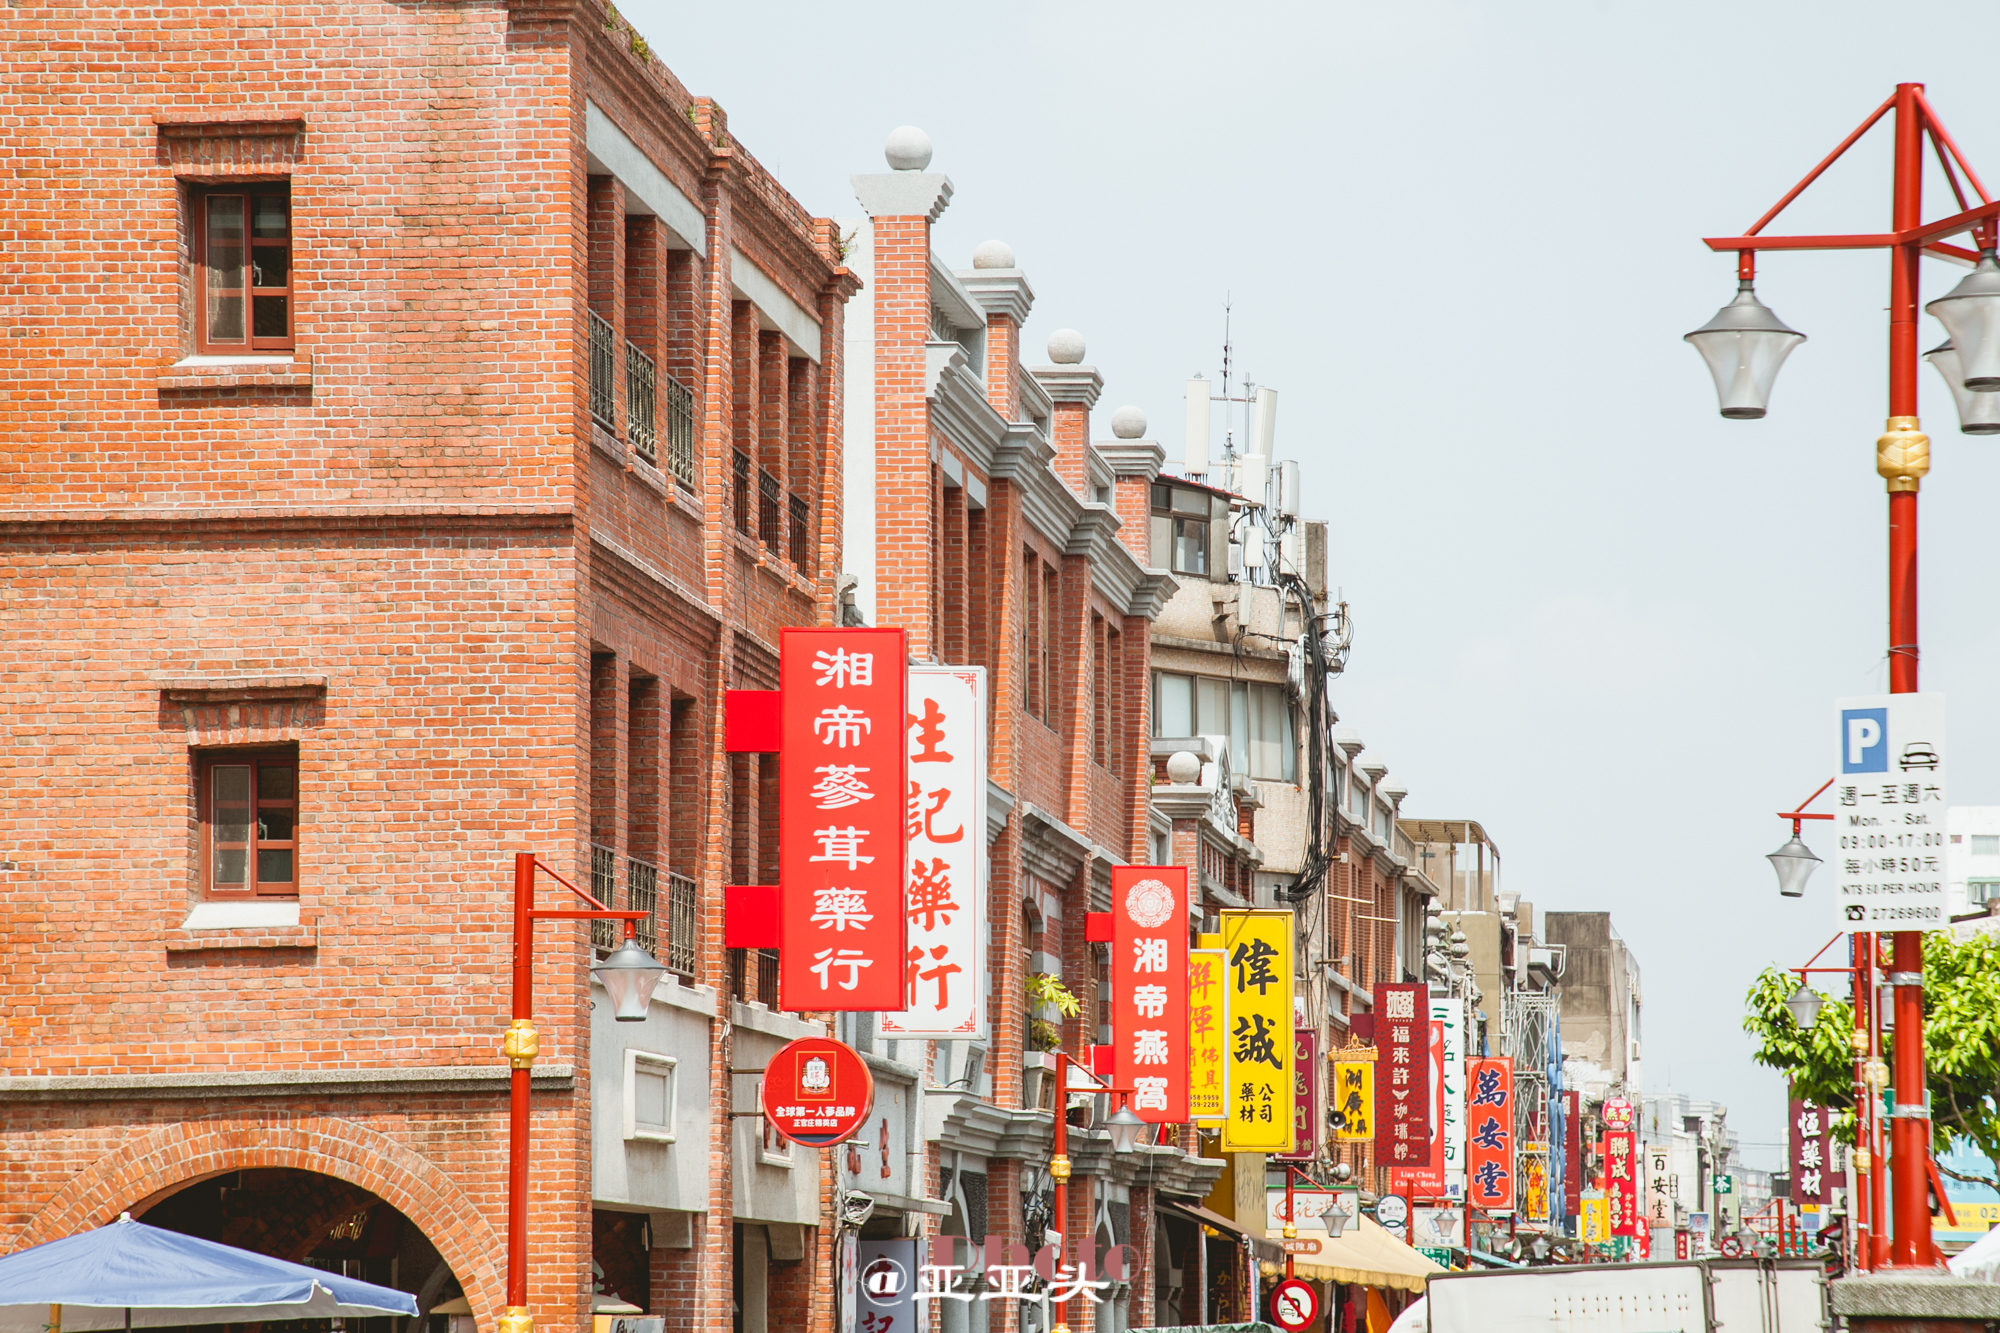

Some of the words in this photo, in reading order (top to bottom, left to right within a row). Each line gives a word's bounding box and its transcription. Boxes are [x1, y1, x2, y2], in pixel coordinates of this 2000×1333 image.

[1848, 718, 1881, 764] P
[1840, 784, 1941, 806] 週一至週六
[809, 646, 875, 991] 湘帝蔘茸藥行
[1849, 815, 1883, 827] Mon.
[1904, 812, 1931, 825] Sat.
[1840, 832, 1943, 849] 09:00-17:00
[1844, 857, 1940, 875] 每小時50元
[1882, 883, 1905, 894] PER
[1907, 882, 1942, 893] HOUR
[1231, 938, 1283, 1070] 偉誠
[1133, 937, 1168, 1111] 湘帝燕窩
[1392, 1026, 1410, 1085] 福來許
[1258, 1083, 1275, 1123] 公司
[1472, 1068, 1508, 1197] 萬安堂
[1416, 1171, 1436, 1179] Cheng
[1651, 1154, 1668, 1218] 百安堂
[1714, 1175, 1730, 1192] 茶
[1279, 1242, 1317, 1252] 城隍廟
